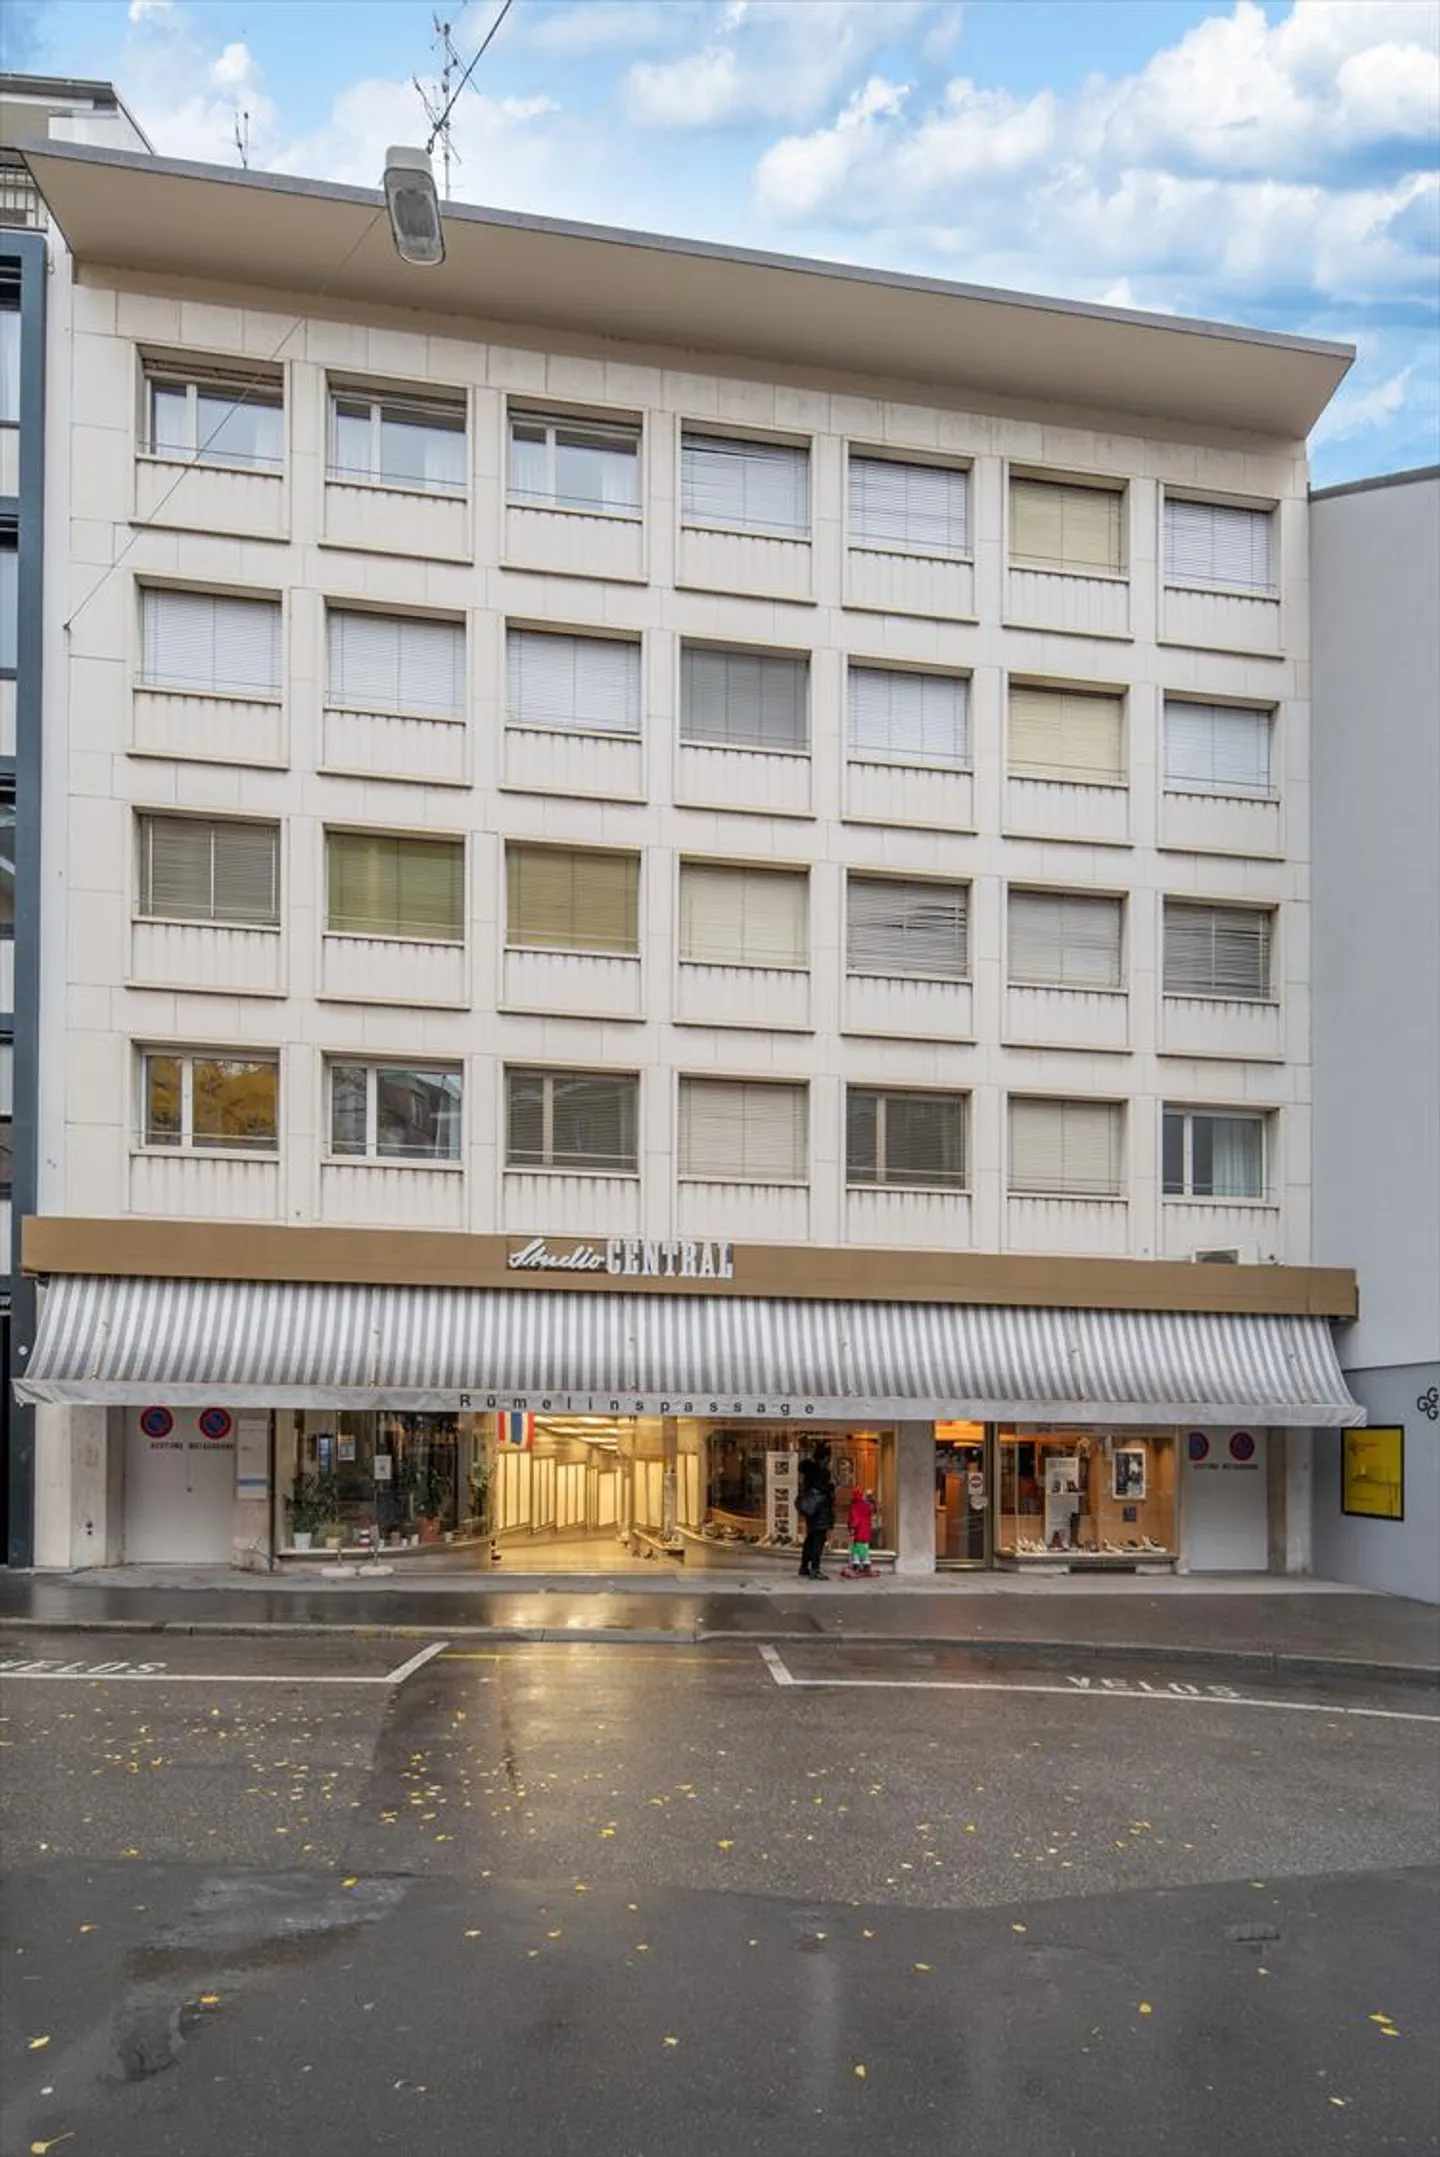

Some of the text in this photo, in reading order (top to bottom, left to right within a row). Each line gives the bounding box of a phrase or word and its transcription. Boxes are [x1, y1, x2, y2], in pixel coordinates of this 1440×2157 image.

[508, 1237, 734, 1278] Studio CENTRAL
[459, 1393, 815, 1416] Rümelinspassage
[1065, 1675, 1241, 1698] VELOS
